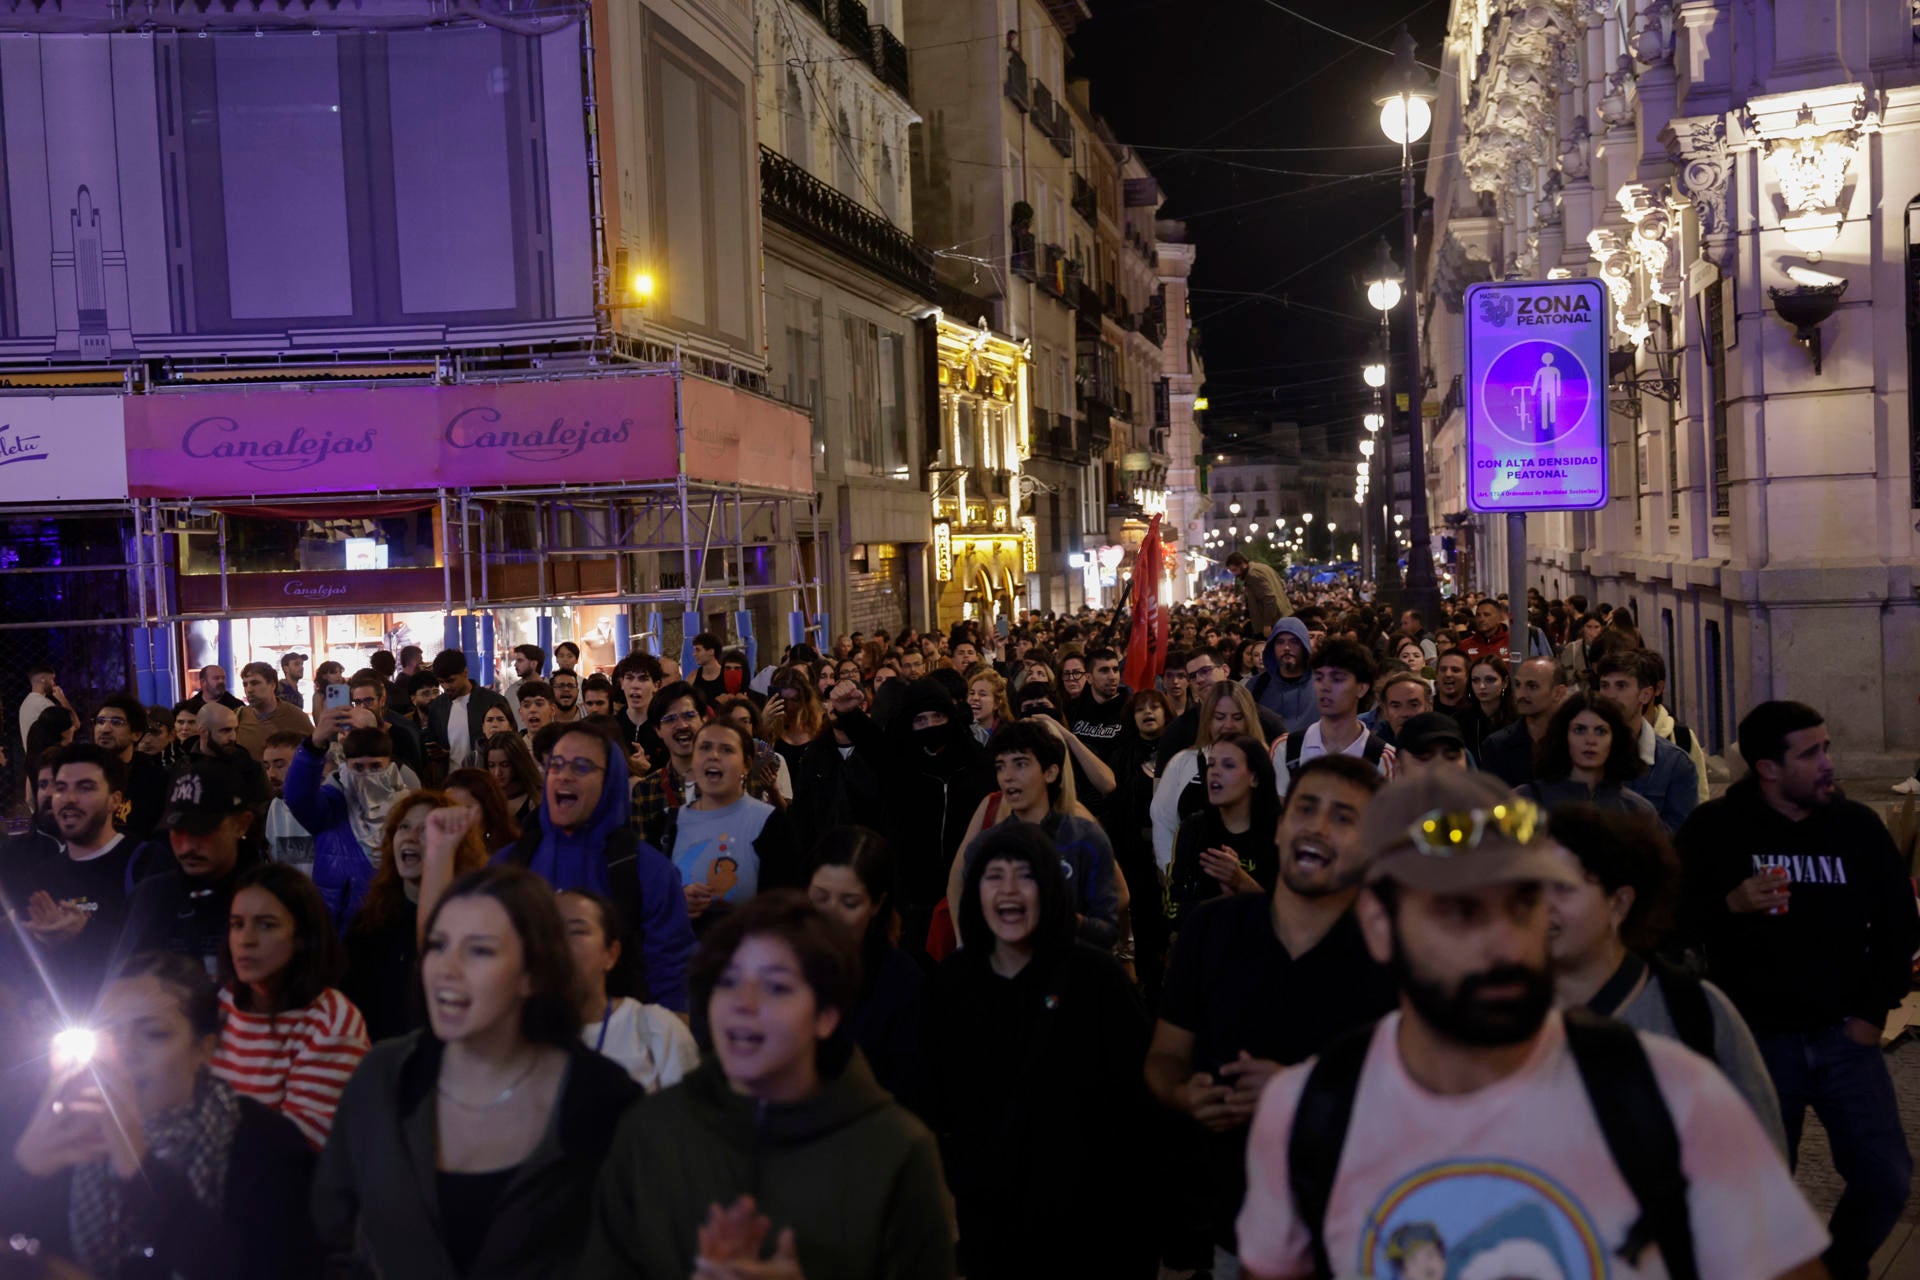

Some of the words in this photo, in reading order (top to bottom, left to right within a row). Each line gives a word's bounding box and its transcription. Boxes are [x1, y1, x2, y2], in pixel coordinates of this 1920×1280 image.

[1517, 295, 1591, 314] ZONA
[1517, 313, 1592, 326] PEATONAL
[445, 406, 634, 462] Canalejas
[182, 416, 377, 472] Canalejas
[1477, 460, 1502, 469] CON
[1506, 459, 1535, 467] ALTA
[1538, 457, 1598, 467] DENSIDAD
[1507, 470, 1568, 479] PEATONAL
[283, 580, 347, 600] Canalejas
[1752, 854, 1847, 884] NIRVANA
